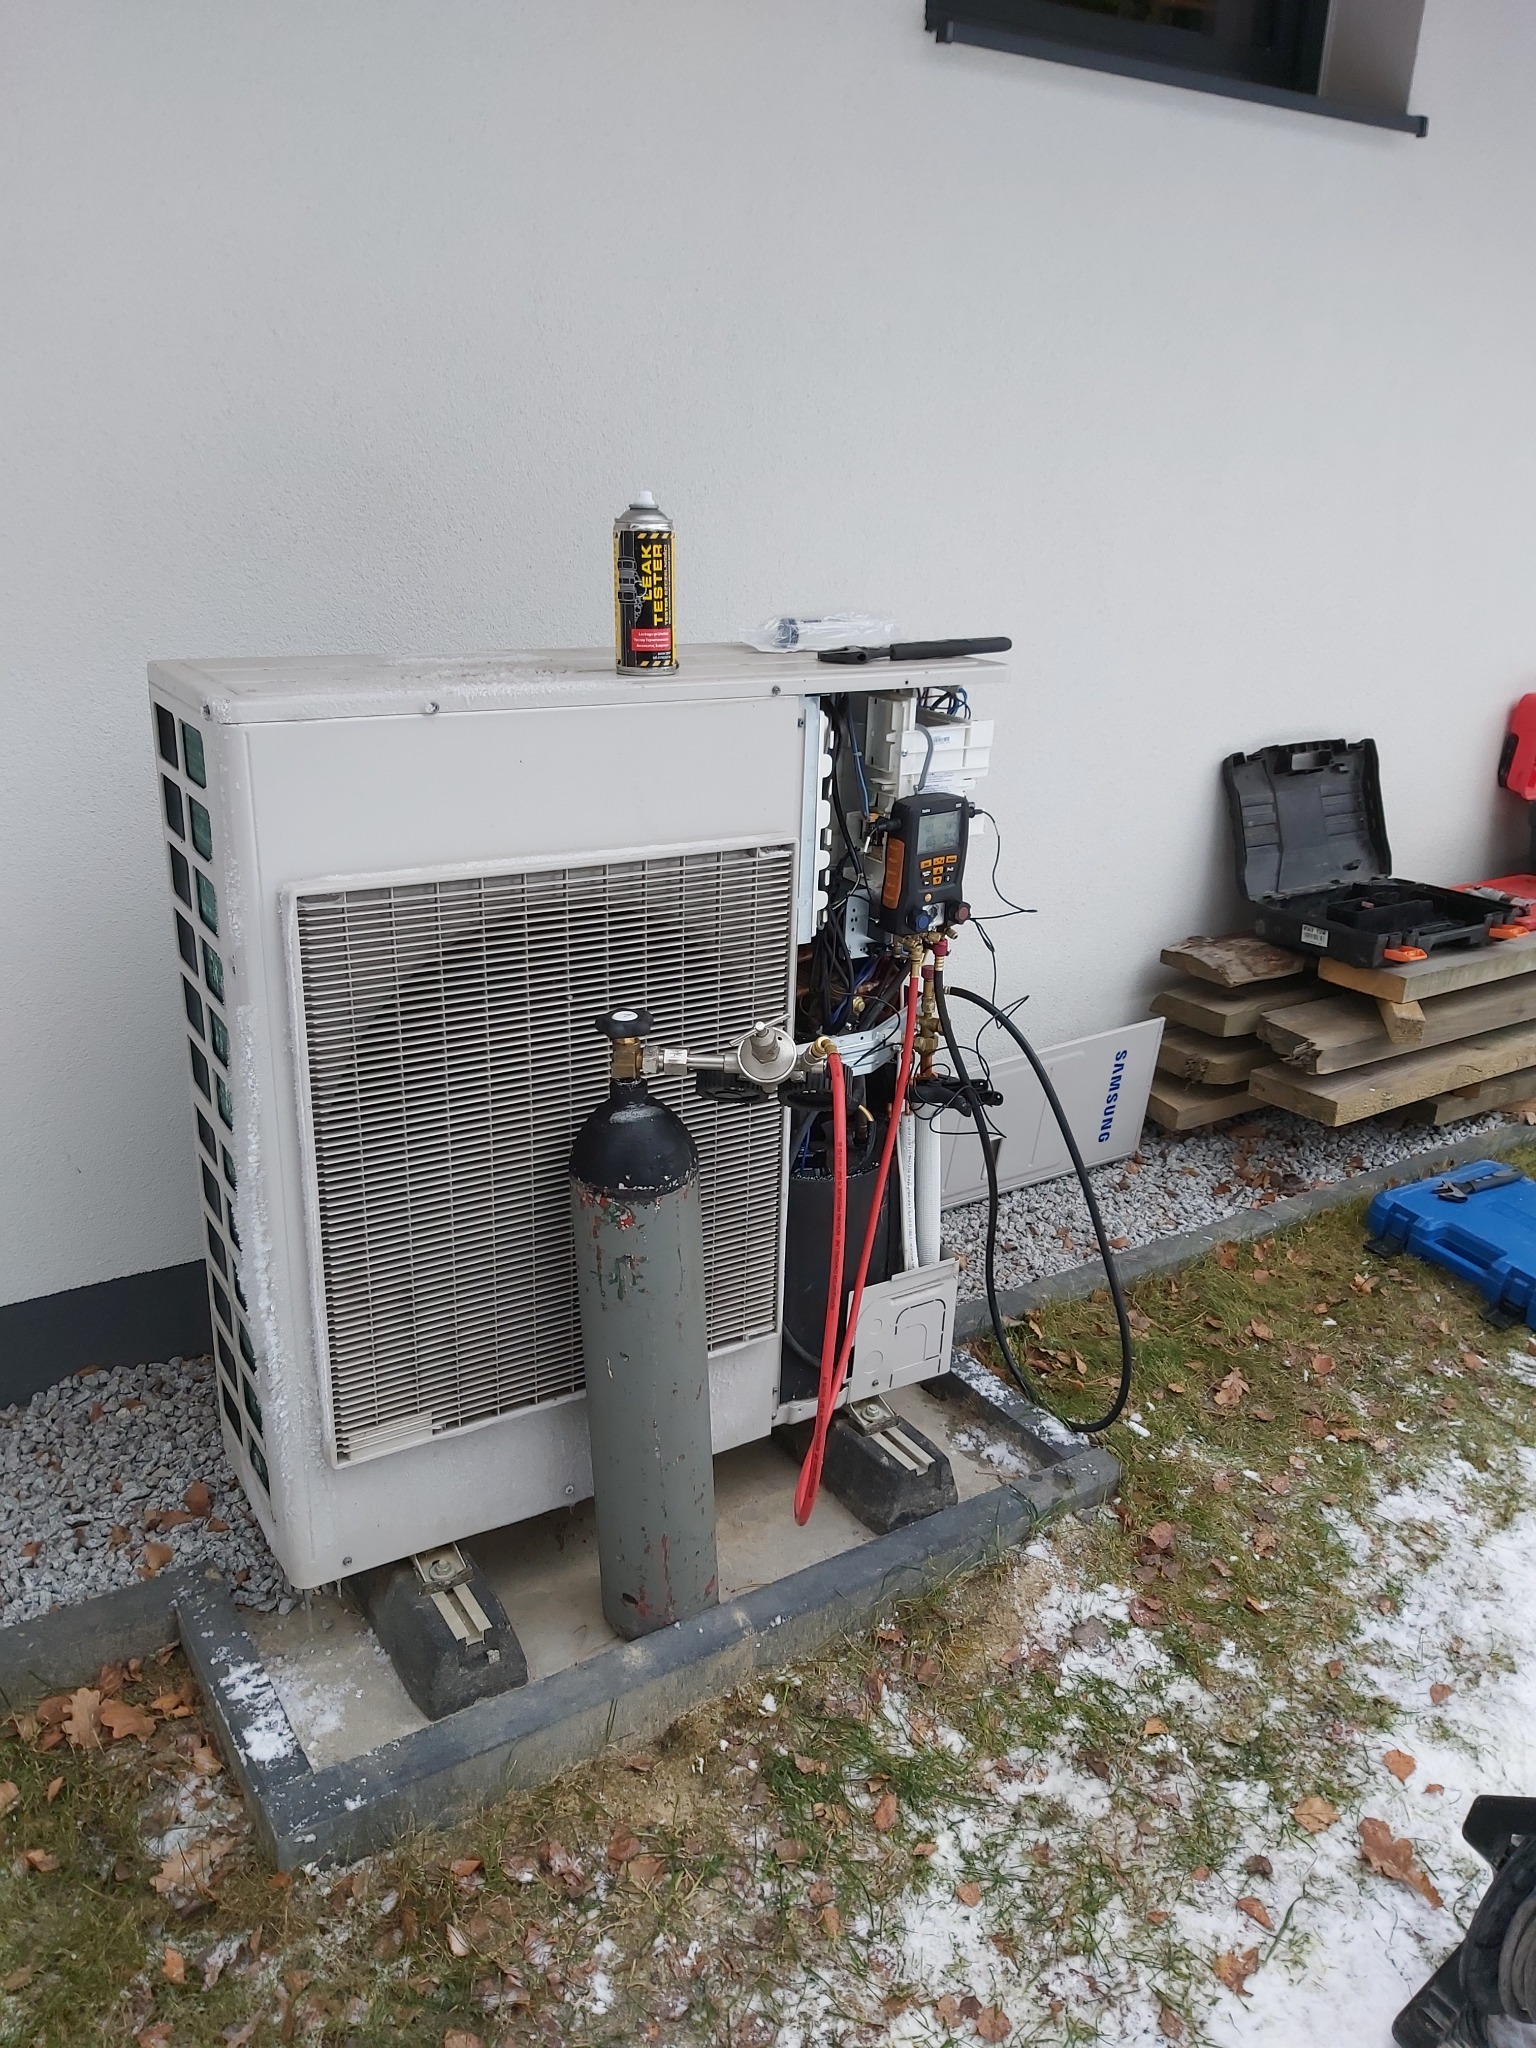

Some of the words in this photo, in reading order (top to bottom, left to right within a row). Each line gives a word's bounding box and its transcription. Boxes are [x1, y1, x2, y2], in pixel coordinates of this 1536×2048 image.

[642, 544, 653, 601] LEAK
[653, 544, 663, 626] TESTER
[1098, 1049, 1128, 1143] SAMSUNG
